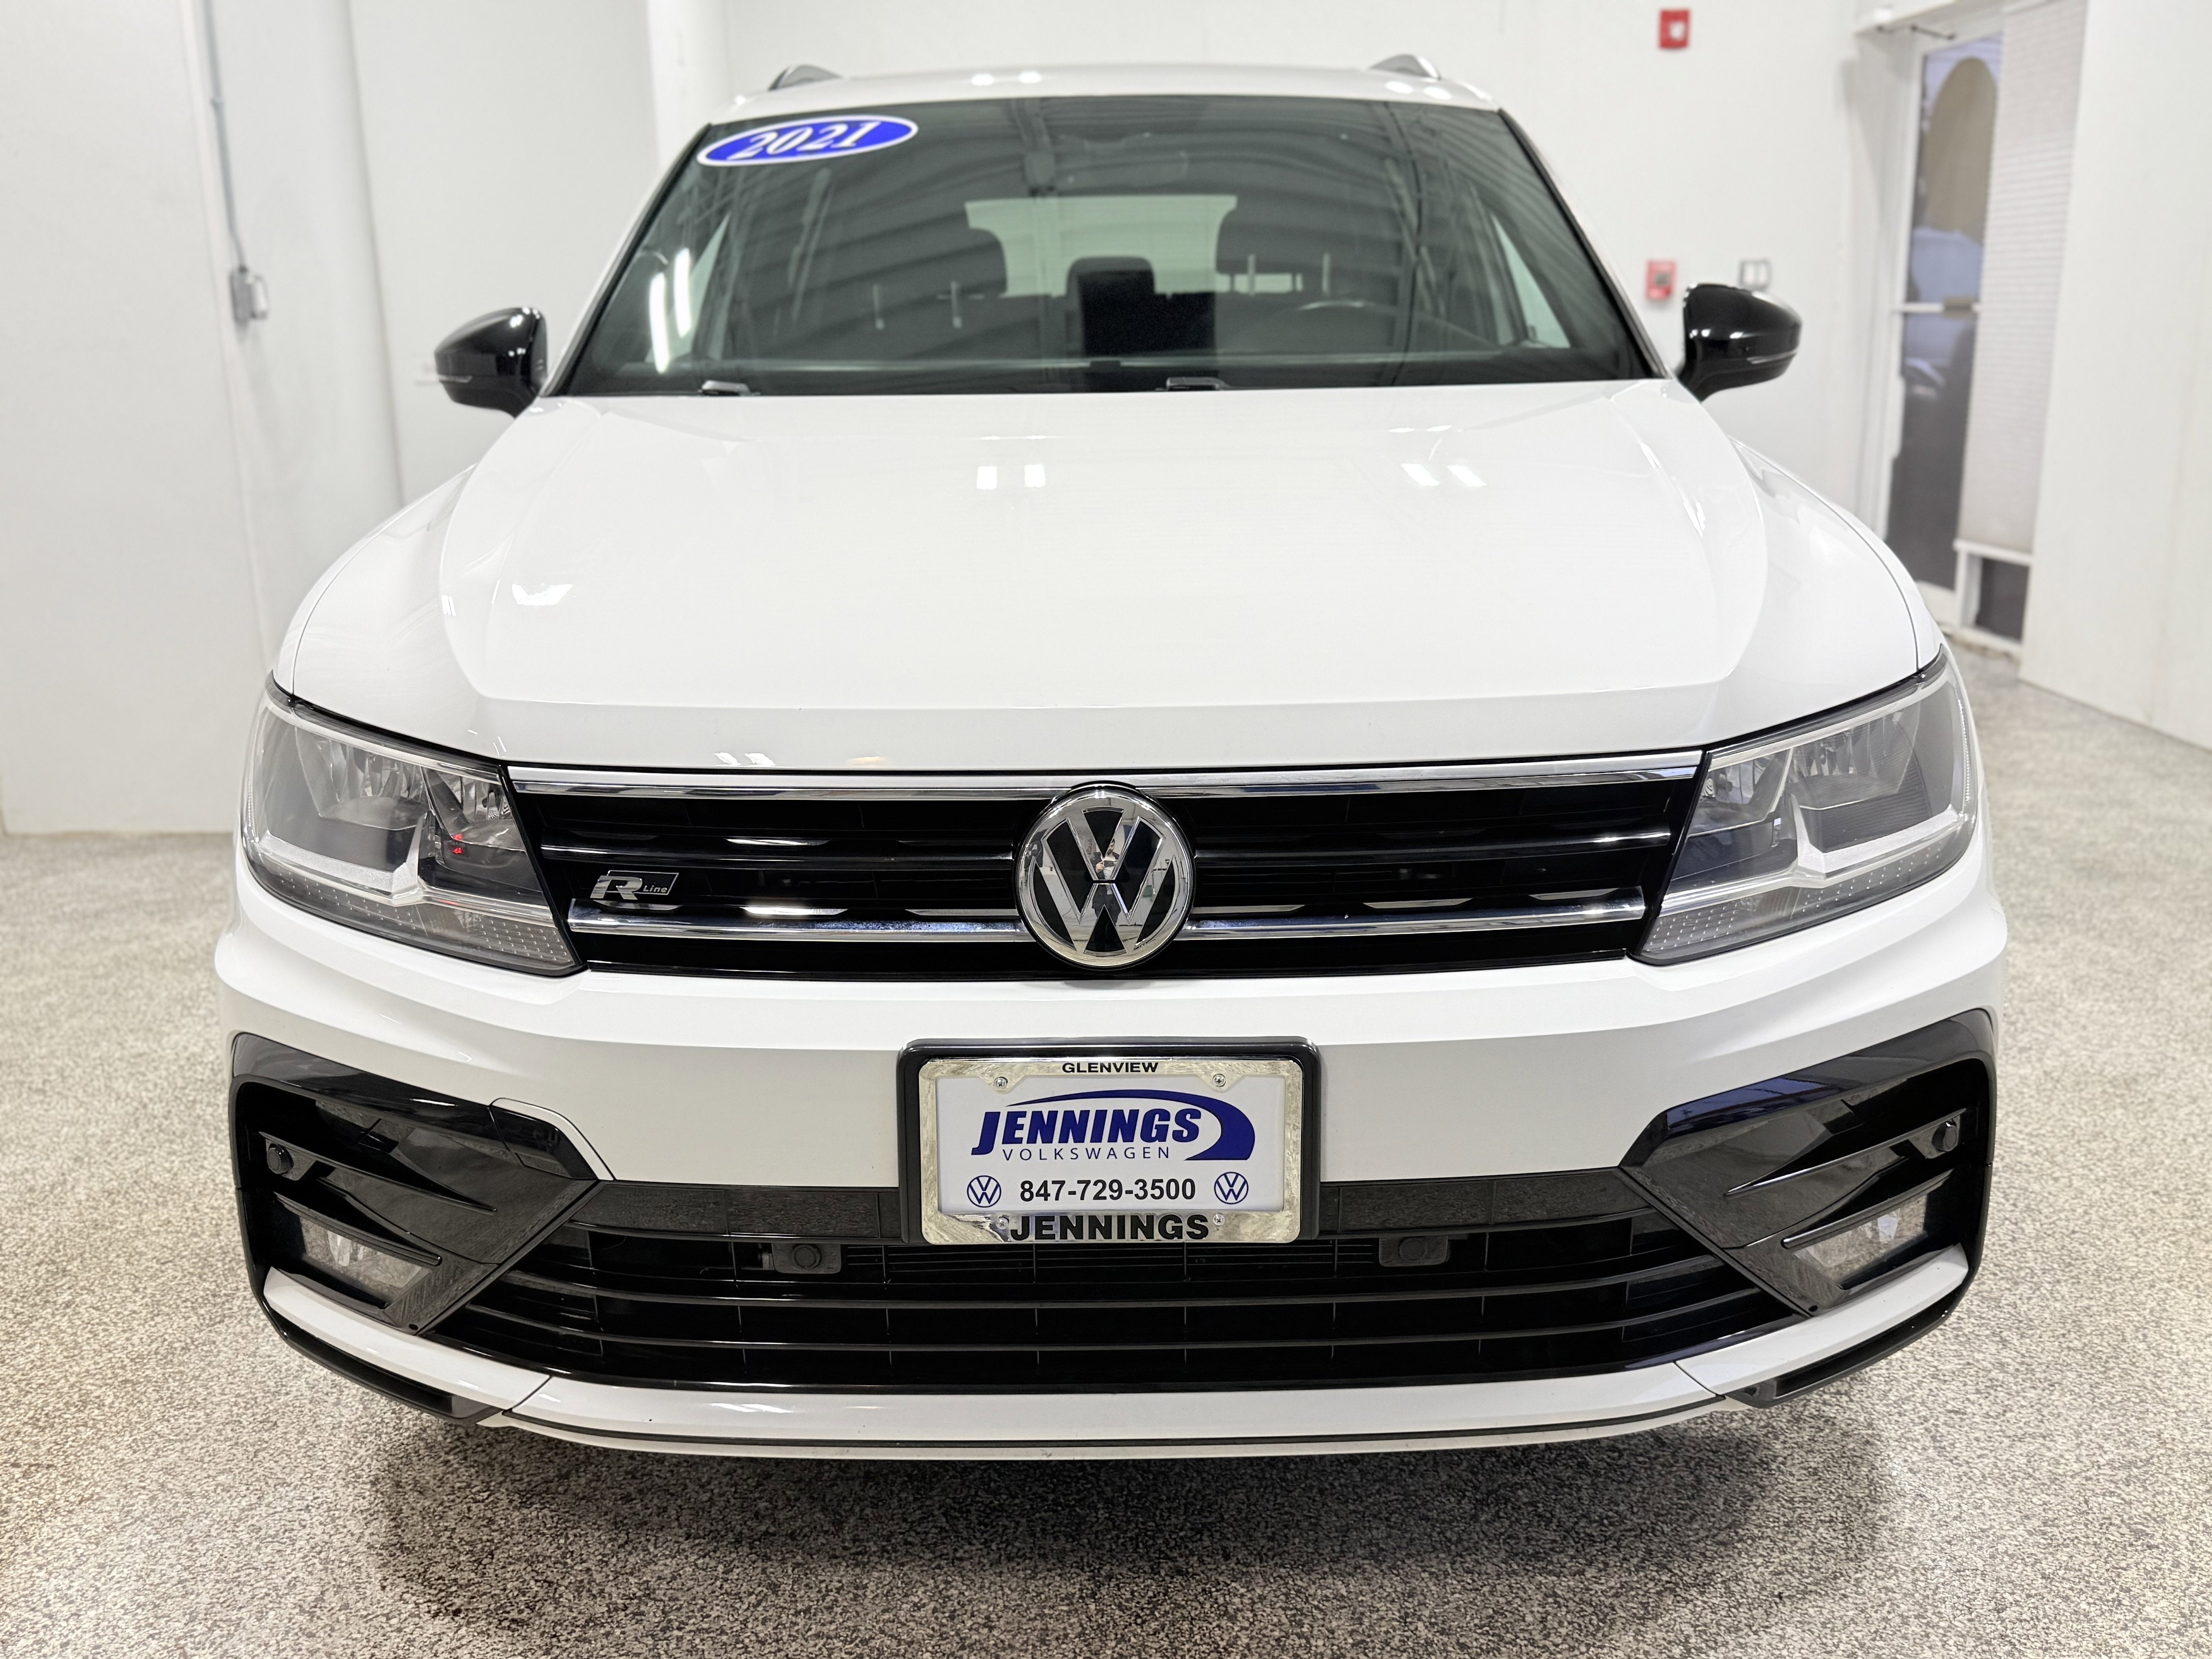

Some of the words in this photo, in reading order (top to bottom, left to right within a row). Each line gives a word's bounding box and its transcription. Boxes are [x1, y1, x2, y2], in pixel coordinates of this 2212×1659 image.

[726, 121, 883, 160] 2021
[590, 875, 643, 900] R
[1062, 1062, 1159, 1073] GLENVIEW
[970, 1108, 1201, 1156] JENNINGS
[1002, 1146, 1169, 1161] VOLKSWAGEN
[1020, 1178, 1196, 1202] 847-729-3500
[1010, 1214, 1209, 1241] JENNINGS
